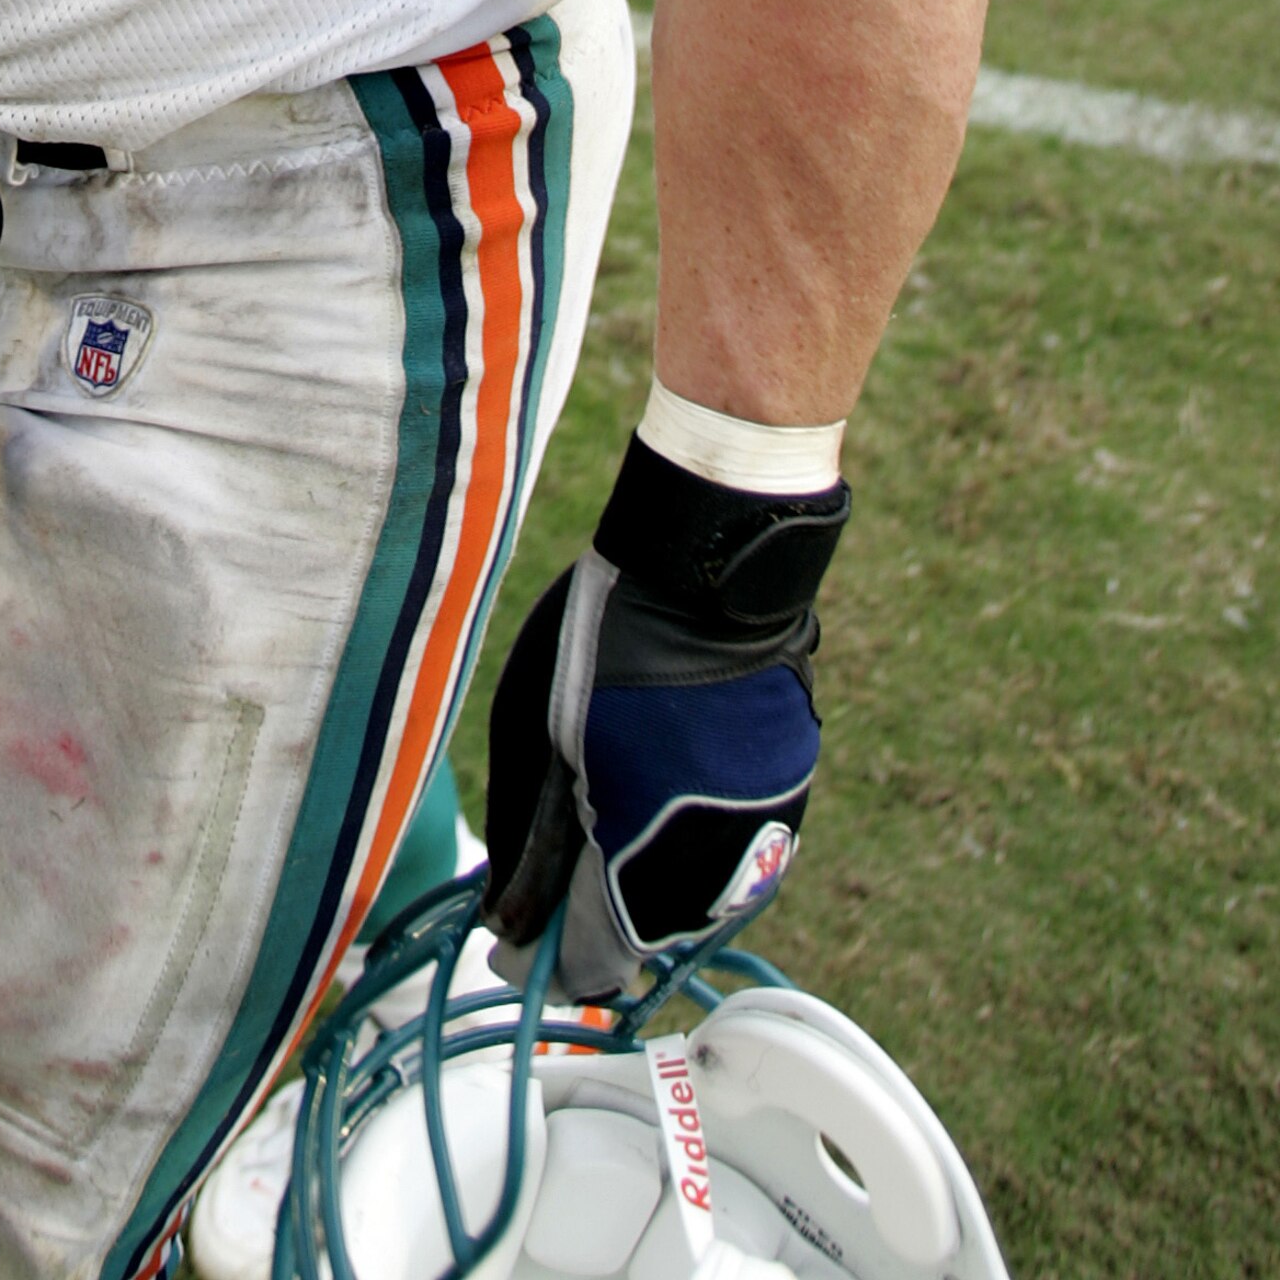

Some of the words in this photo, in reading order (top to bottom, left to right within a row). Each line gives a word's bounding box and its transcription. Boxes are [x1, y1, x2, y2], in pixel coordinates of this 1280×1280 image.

[77, 300, 150, 334] EQUIPMENT
[78, 346, 117, 384] NFL
[656, 1054, 711, 1213] Riddell
